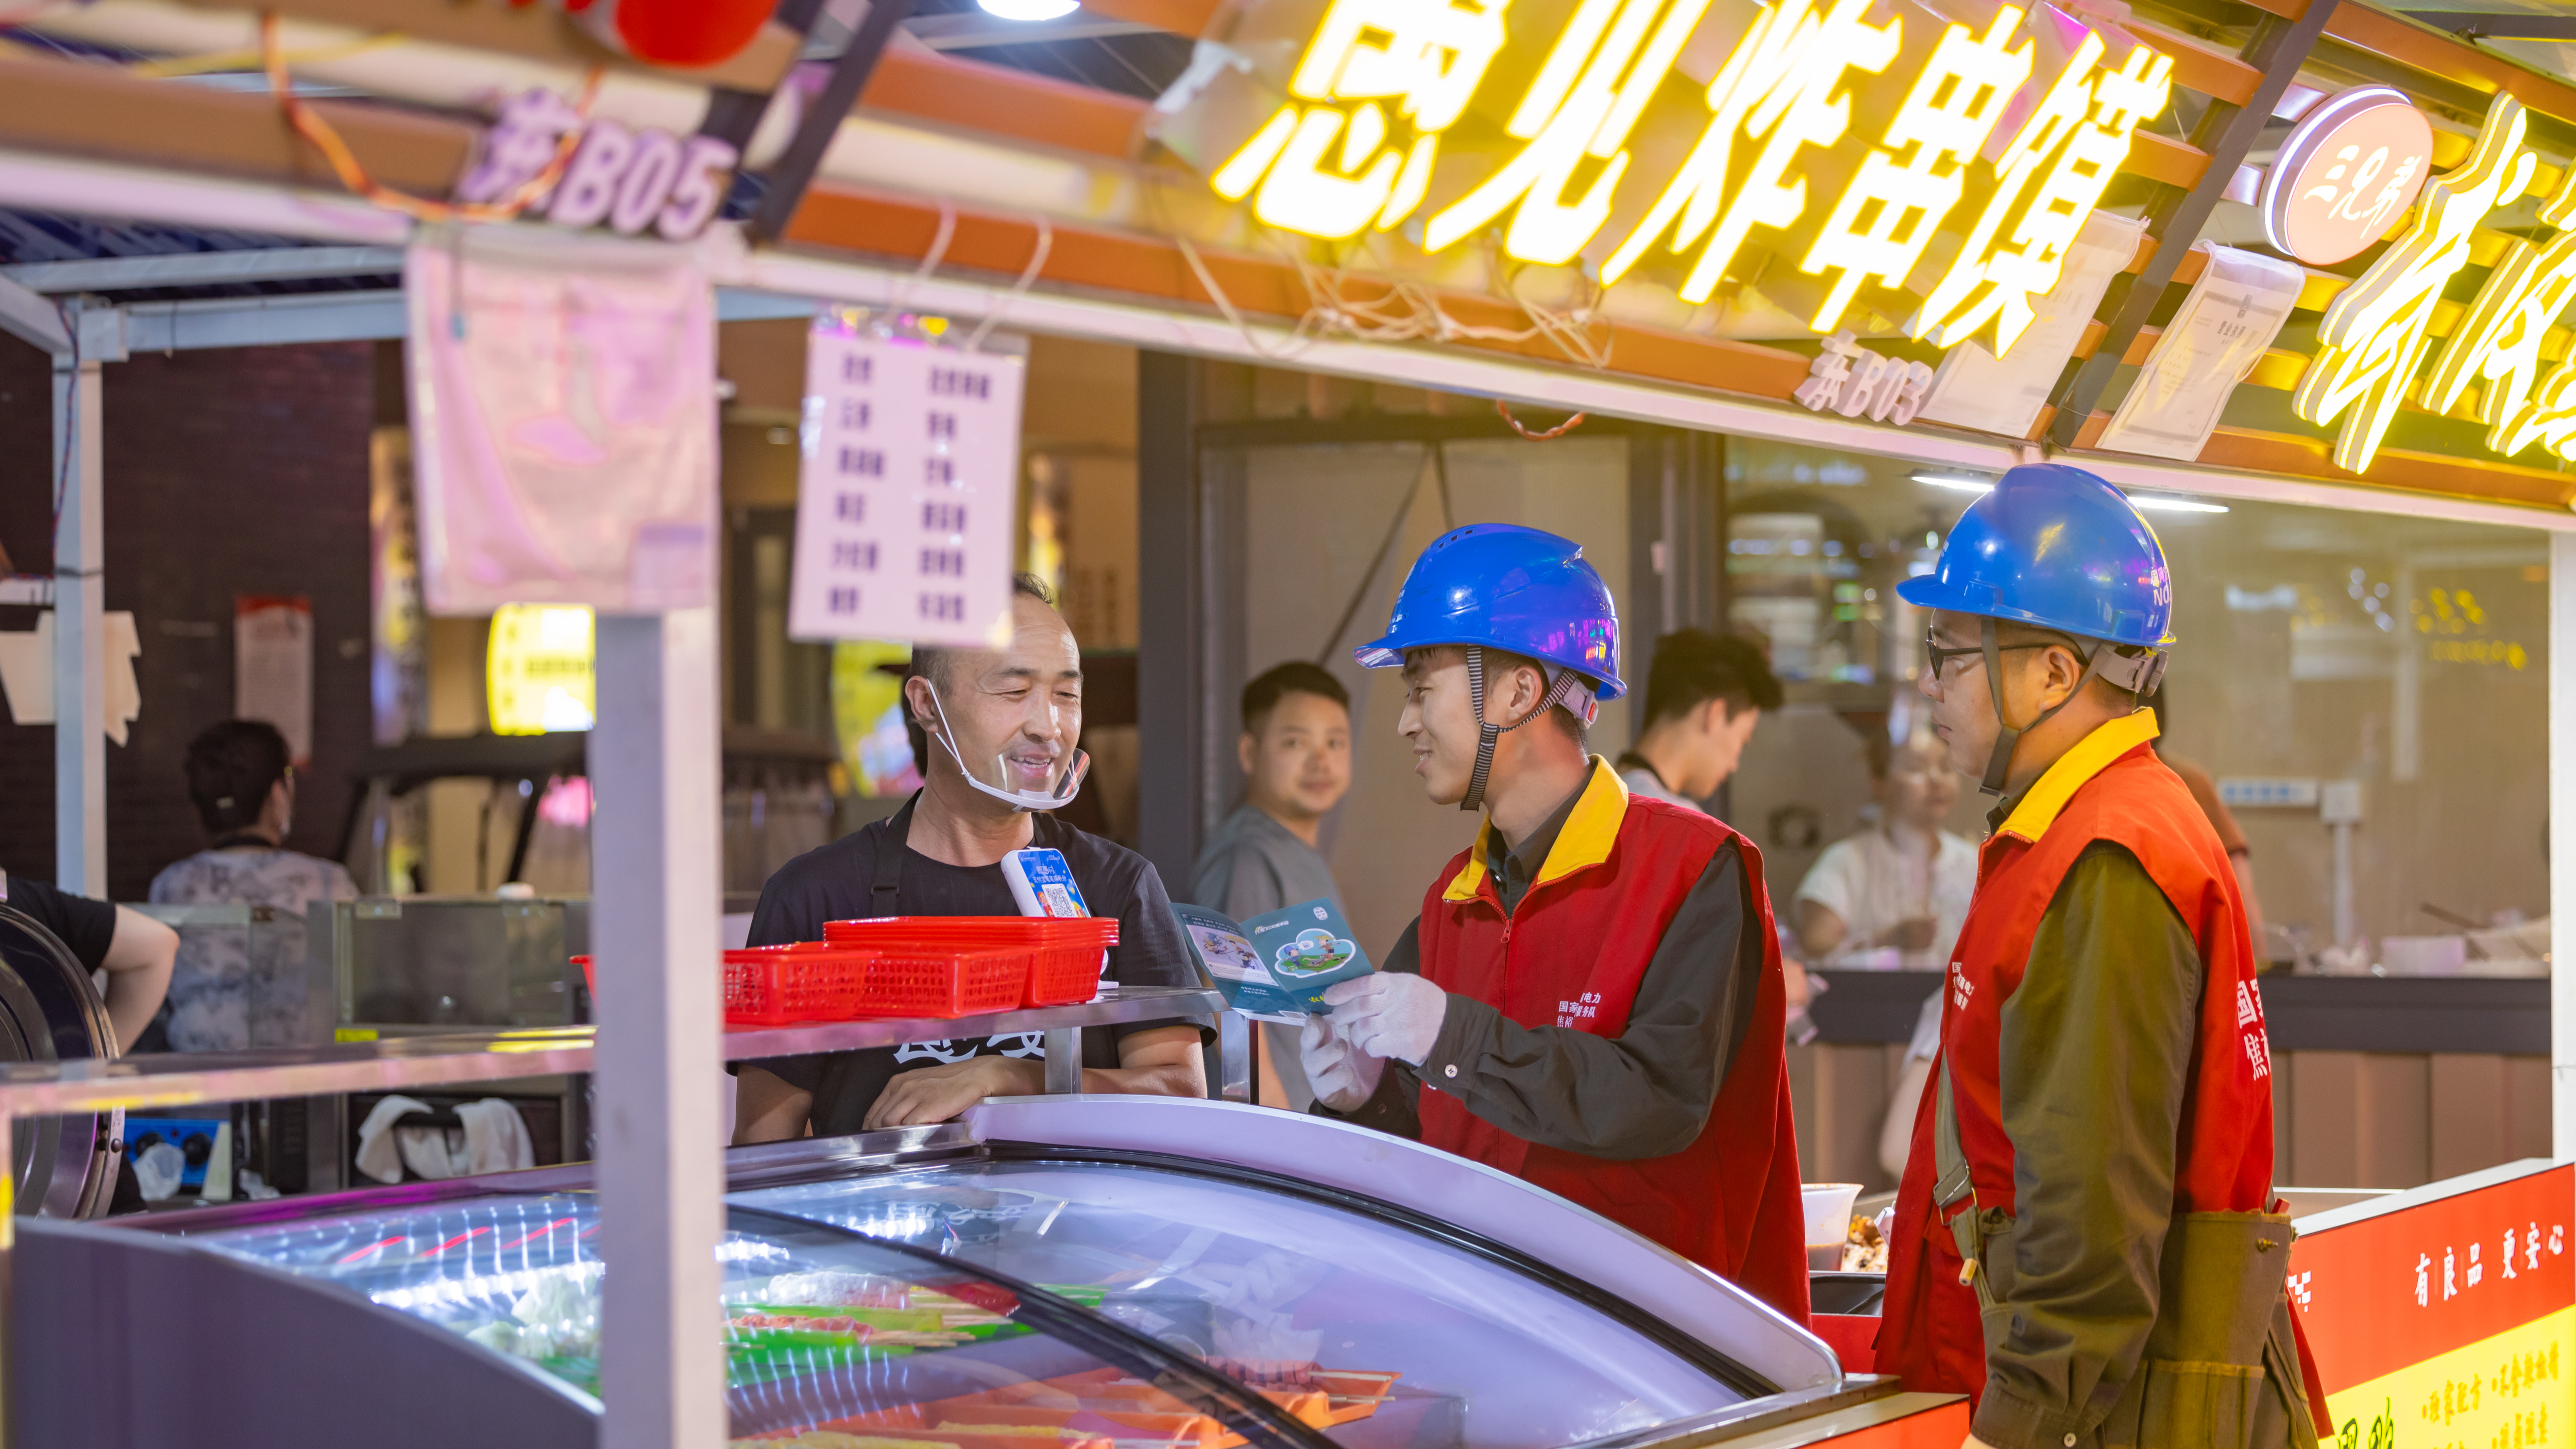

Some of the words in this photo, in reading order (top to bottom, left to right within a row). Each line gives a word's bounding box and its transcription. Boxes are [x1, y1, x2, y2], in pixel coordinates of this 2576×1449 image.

[2303, 145, 2422, 239] 三兄弟
[1794, 328, 1933, 426] 东B03
[2414, 1242, 2483, 1307] 有良品
[2502, 1221, 2564, 1279] 更安心
